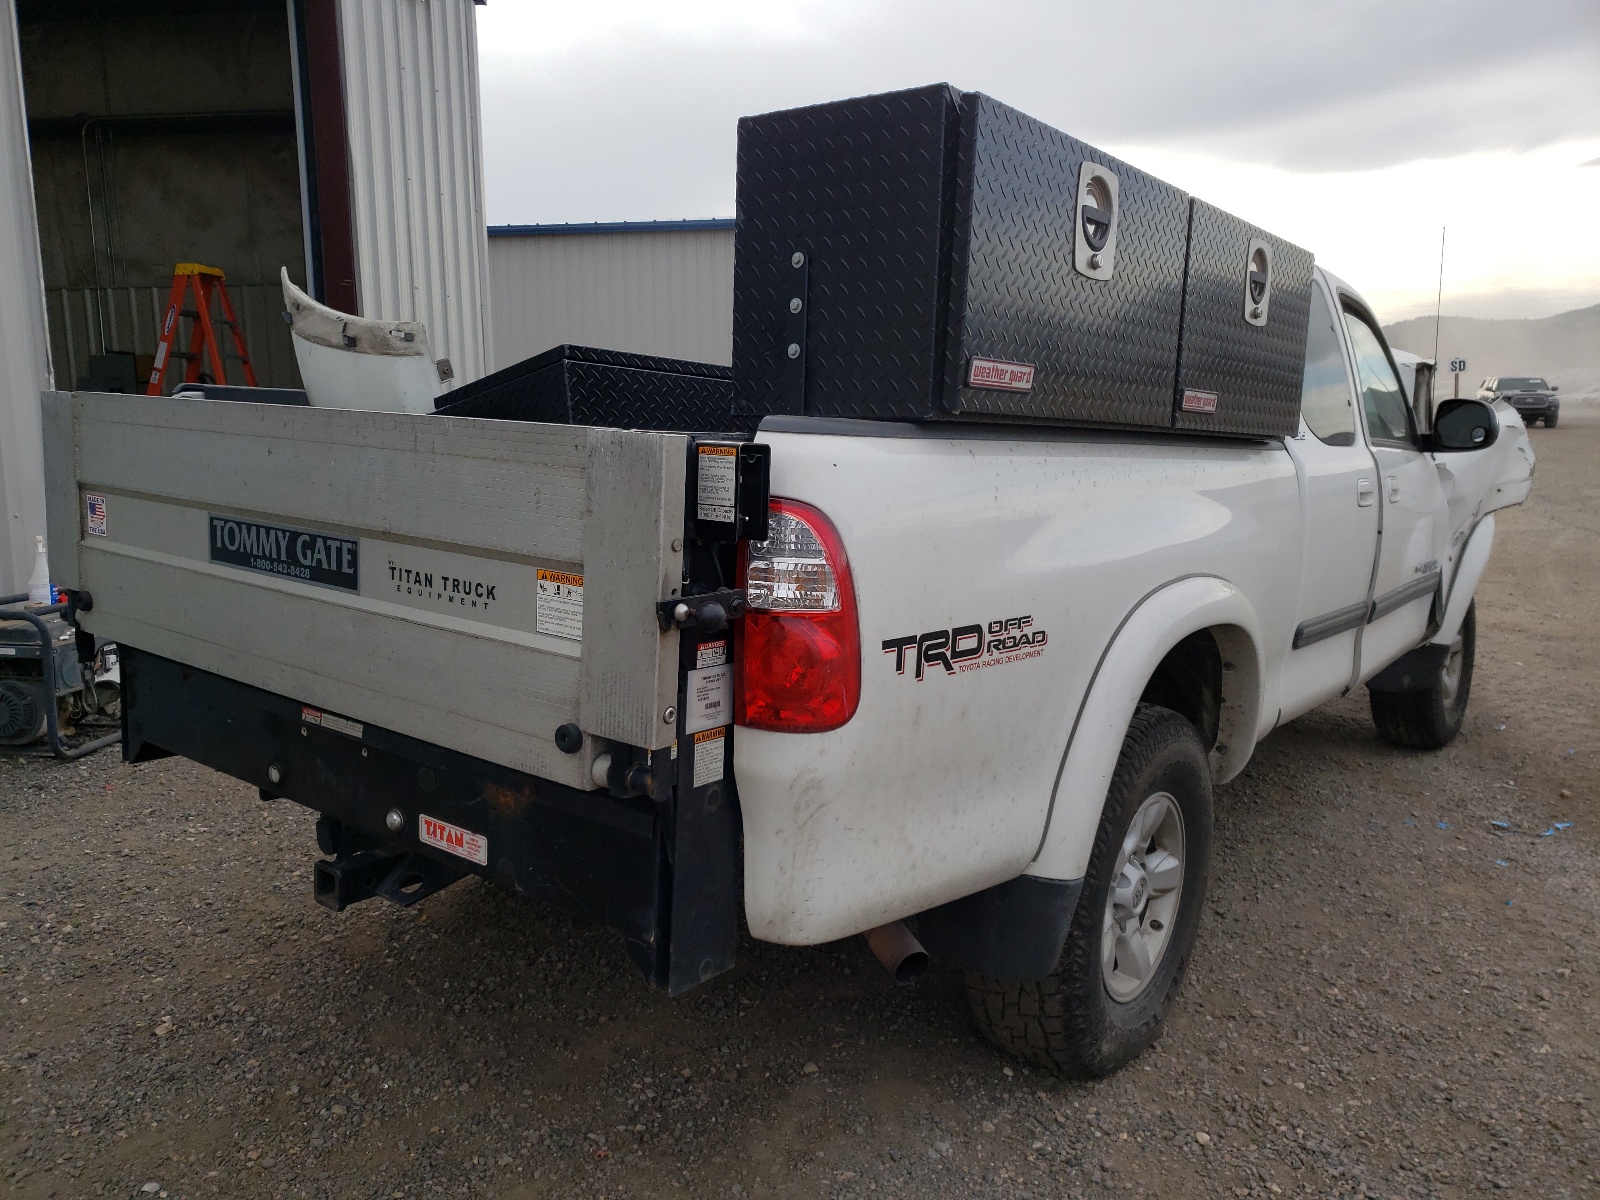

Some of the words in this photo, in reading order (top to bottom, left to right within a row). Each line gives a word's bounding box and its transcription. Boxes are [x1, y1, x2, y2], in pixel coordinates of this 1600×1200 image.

[973, 364, 1008, 381] weather
[1009, 369, 1033, 384] guard
[1450, 360, 1466, 372] SD
[707, 447, 734, 456] WARNING
[213, 519, 290, 561] TOMMY
[296, 534, 355, 575] GATE
[390, 566, 433, 589] TITAN
[441, 576, 497, 601] TRUCK
[549, 572, 584, 586] WARNING
[397, 584, 489, 610] EQUIPMENT
[988, 615, 1033, 638] OFF
[881, 623, 985, 682] TRD
[987, 630, 1048, 656] ROAD
[958, 663, 981, 673] TOYOTA
[982, 657, 1004, 669] RACING
[1004, 649, 1045, 664] DEVELOPMENT
[424, 819, 464, 848] TITAN
